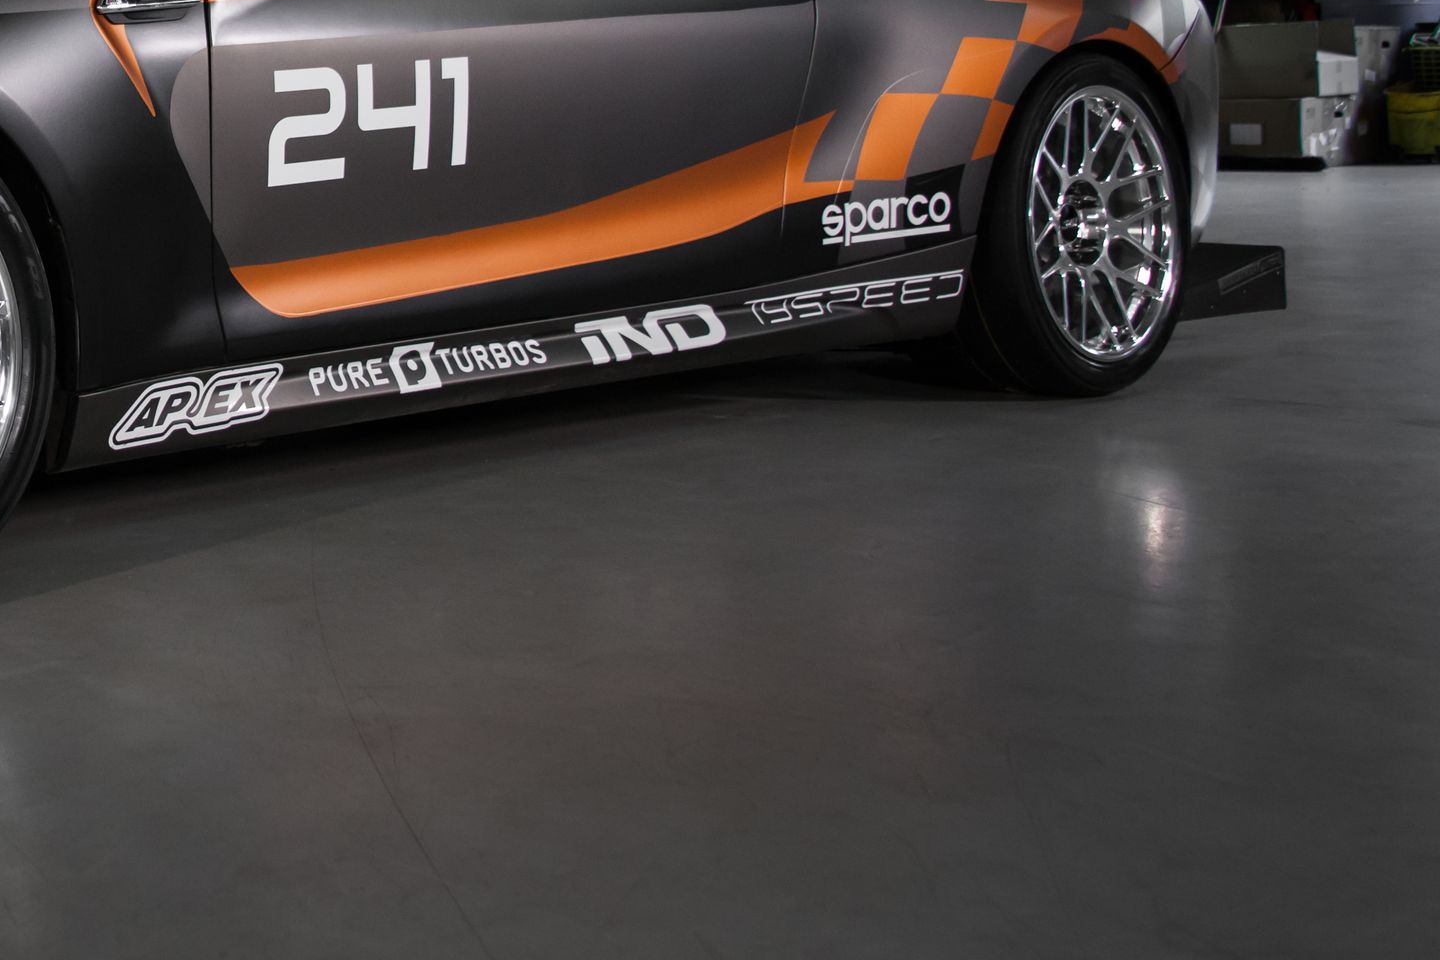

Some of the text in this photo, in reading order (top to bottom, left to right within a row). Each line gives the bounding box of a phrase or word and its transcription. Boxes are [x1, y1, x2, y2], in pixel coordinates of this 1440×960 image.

[267, 56, 470, 188] 241
[821, 191, 952, 247] sparco
[308, 339, 548, 396] PURE TURBOS
[117, 370, 273, 441] APEX
